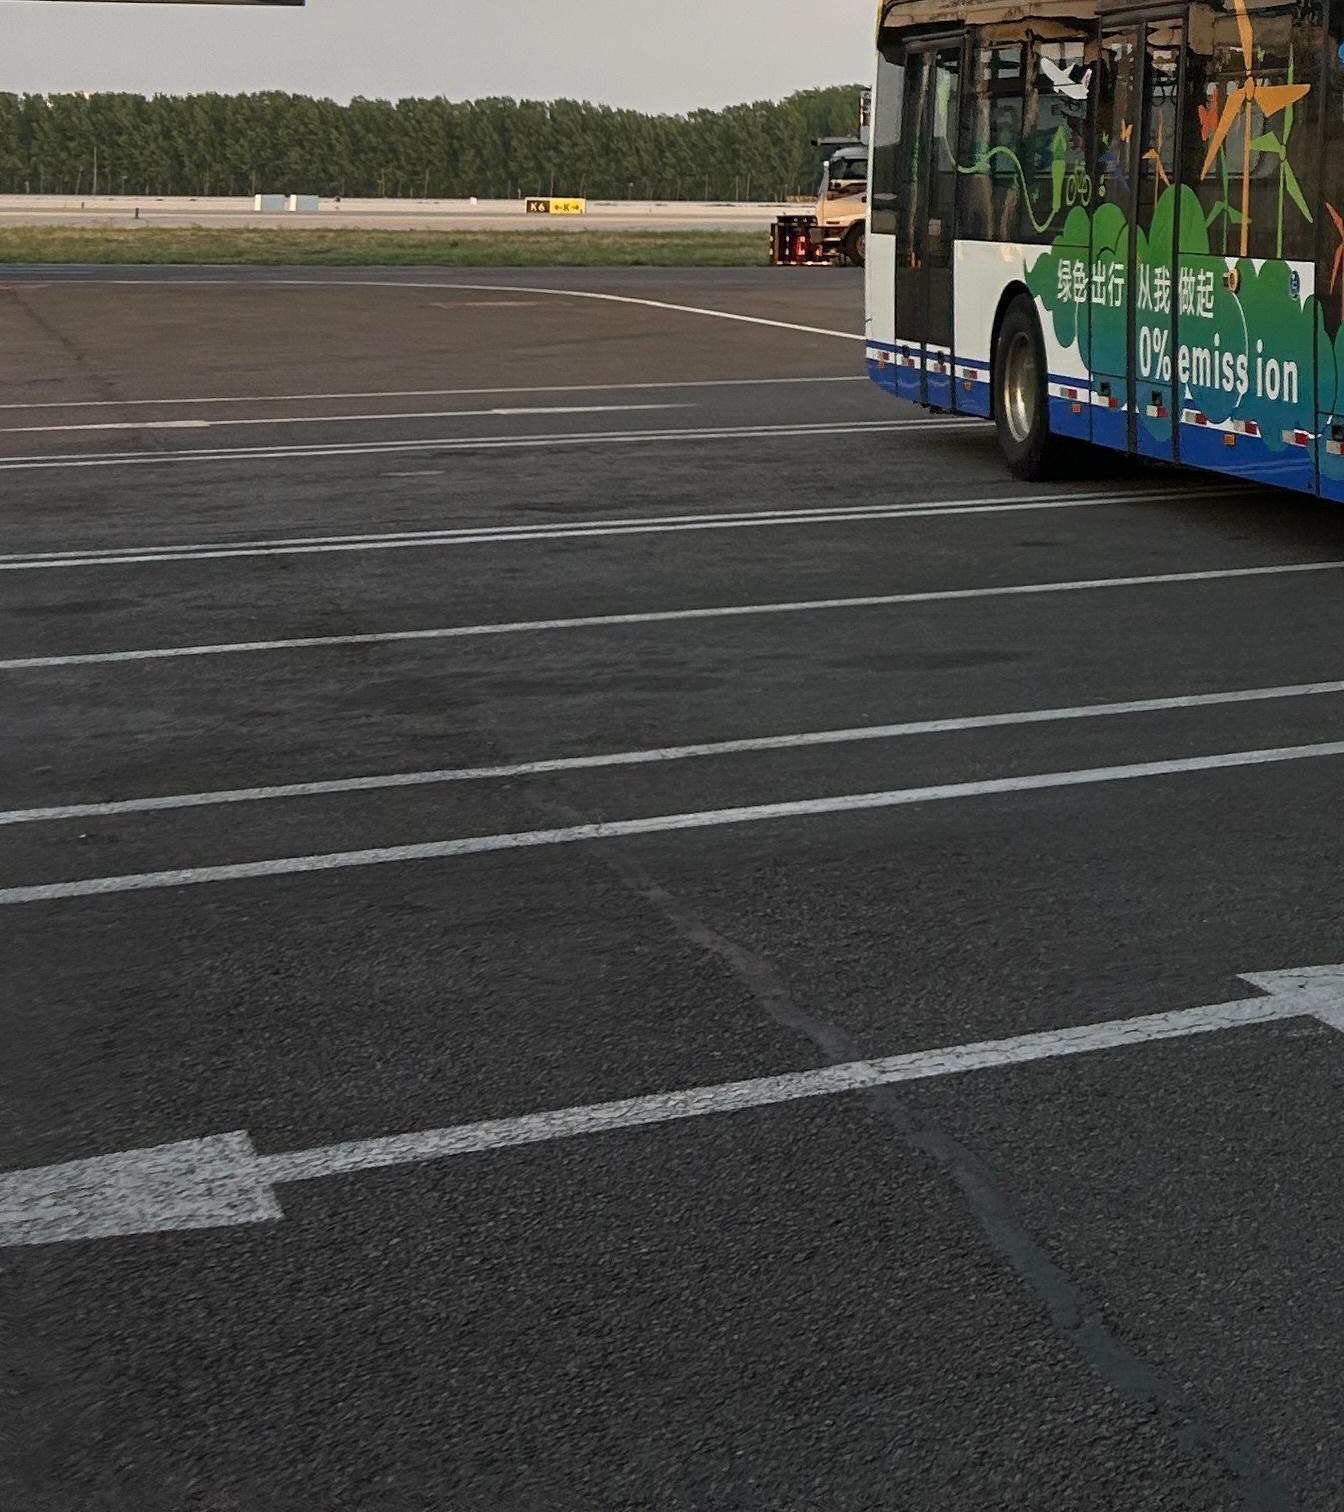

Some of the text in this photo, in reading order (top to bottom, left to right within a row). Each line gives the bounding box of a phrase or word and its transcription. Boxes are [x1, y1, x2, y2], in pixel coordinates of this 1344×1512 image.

[1057, 258, 1215, 319] 绿色出行 从我做起
[1139, 326, 1171, 381] 0%
